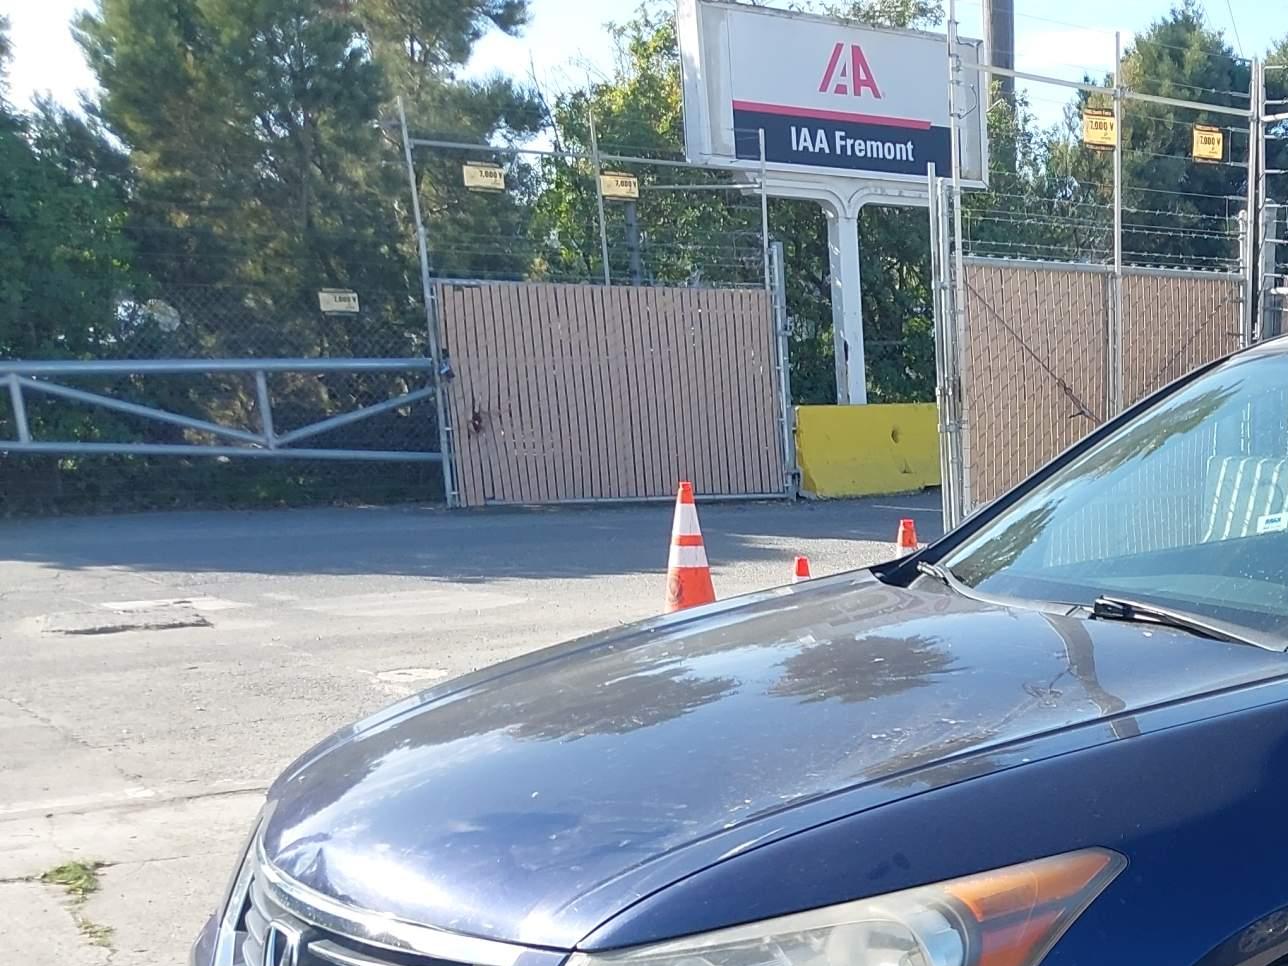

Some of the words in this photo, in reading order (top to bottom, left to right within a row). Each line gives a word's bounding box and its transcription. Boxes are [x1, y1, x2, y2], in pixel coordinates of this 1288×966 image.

[1109, 121, 1114, 131] V
[789, 126, 830, 154] IAA
[834, 130, 914, 162] Fremont
[1216, 137, 1221, 147] V
